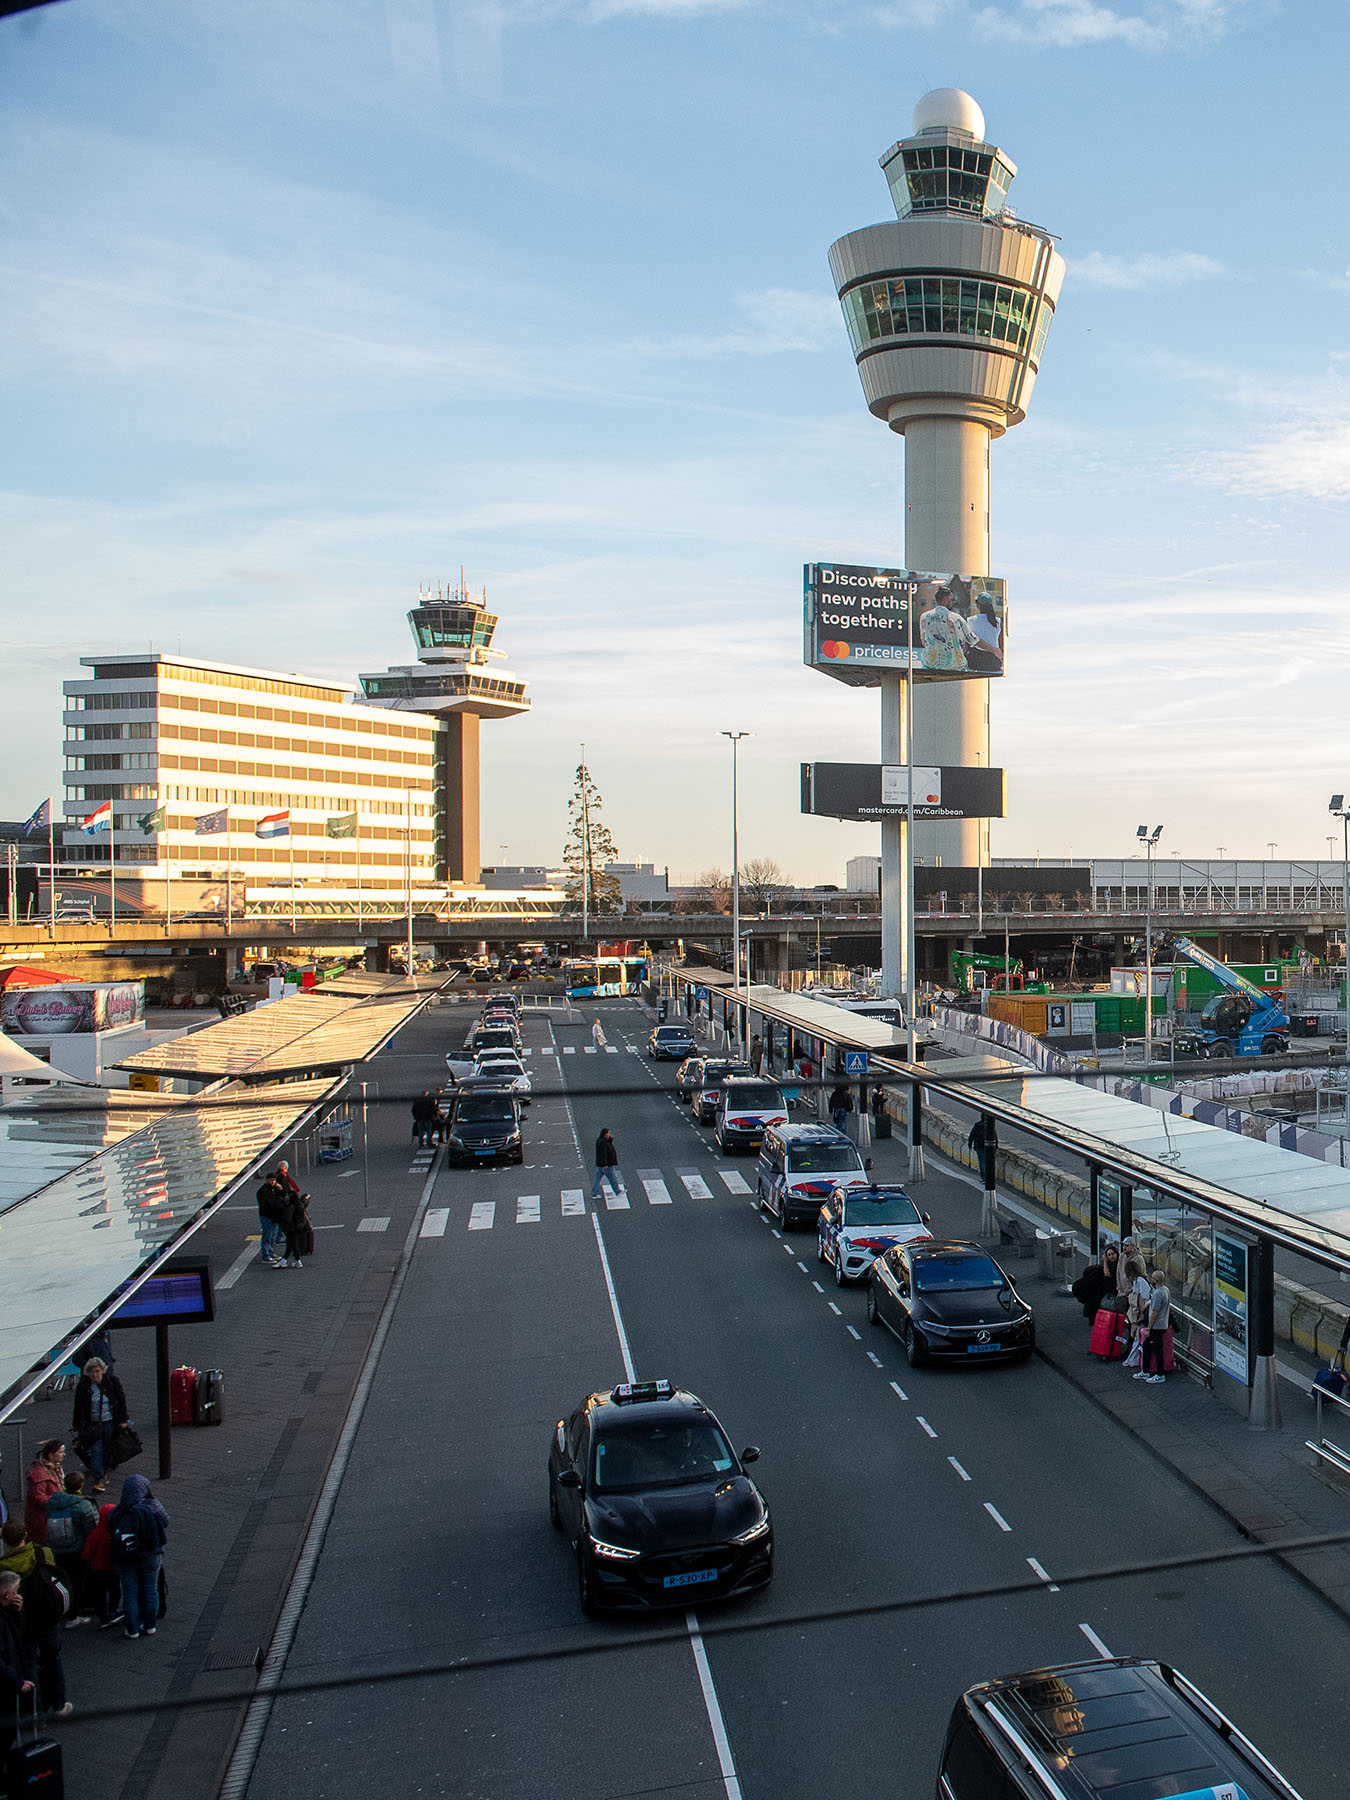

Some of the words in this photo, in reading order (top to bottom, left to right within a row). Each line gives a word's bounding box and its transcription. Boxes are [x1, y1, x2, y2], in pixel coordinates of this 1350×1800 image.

[822, 593, 856, 606] new
[861, 595, 908, 610] paths
[855, 644, 918, 659] priceless
[858, 806, 964, 816] mastercard.cm/Caribbean
[670, 1570, 713, 1585] R-530-XP
